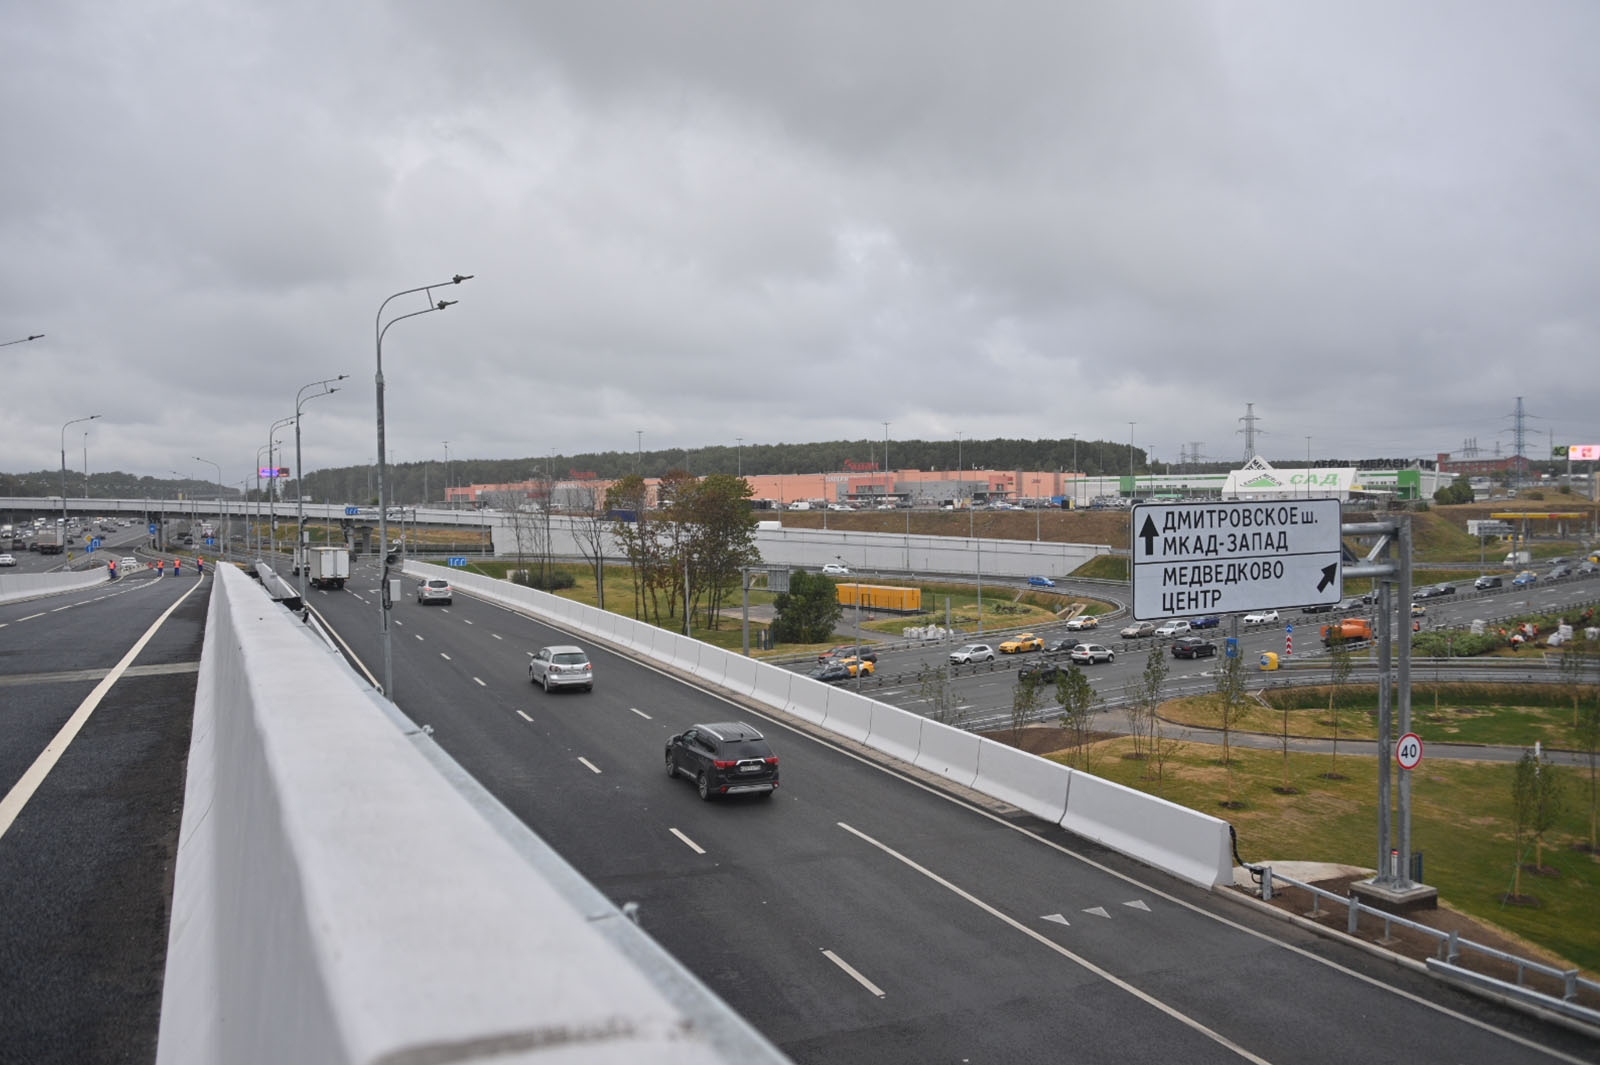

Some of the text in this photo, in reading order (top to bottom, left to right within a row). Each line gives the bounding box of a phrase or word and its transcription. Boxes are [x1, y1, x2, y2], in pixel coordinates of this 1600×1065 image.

[1289, 473, 1339, 487] САД
[1162, 506, 1299, 533] ДМИТРОВСКОЕ
[1162, 531, 1289, 556] МКАД-ЗАПАД
[1162, 560, 1285, 587] МЕДВЕДКОВО
[1162, 589, 1222, 615] ЦЕНТР
[1401, 743, 1417, 759] 40
